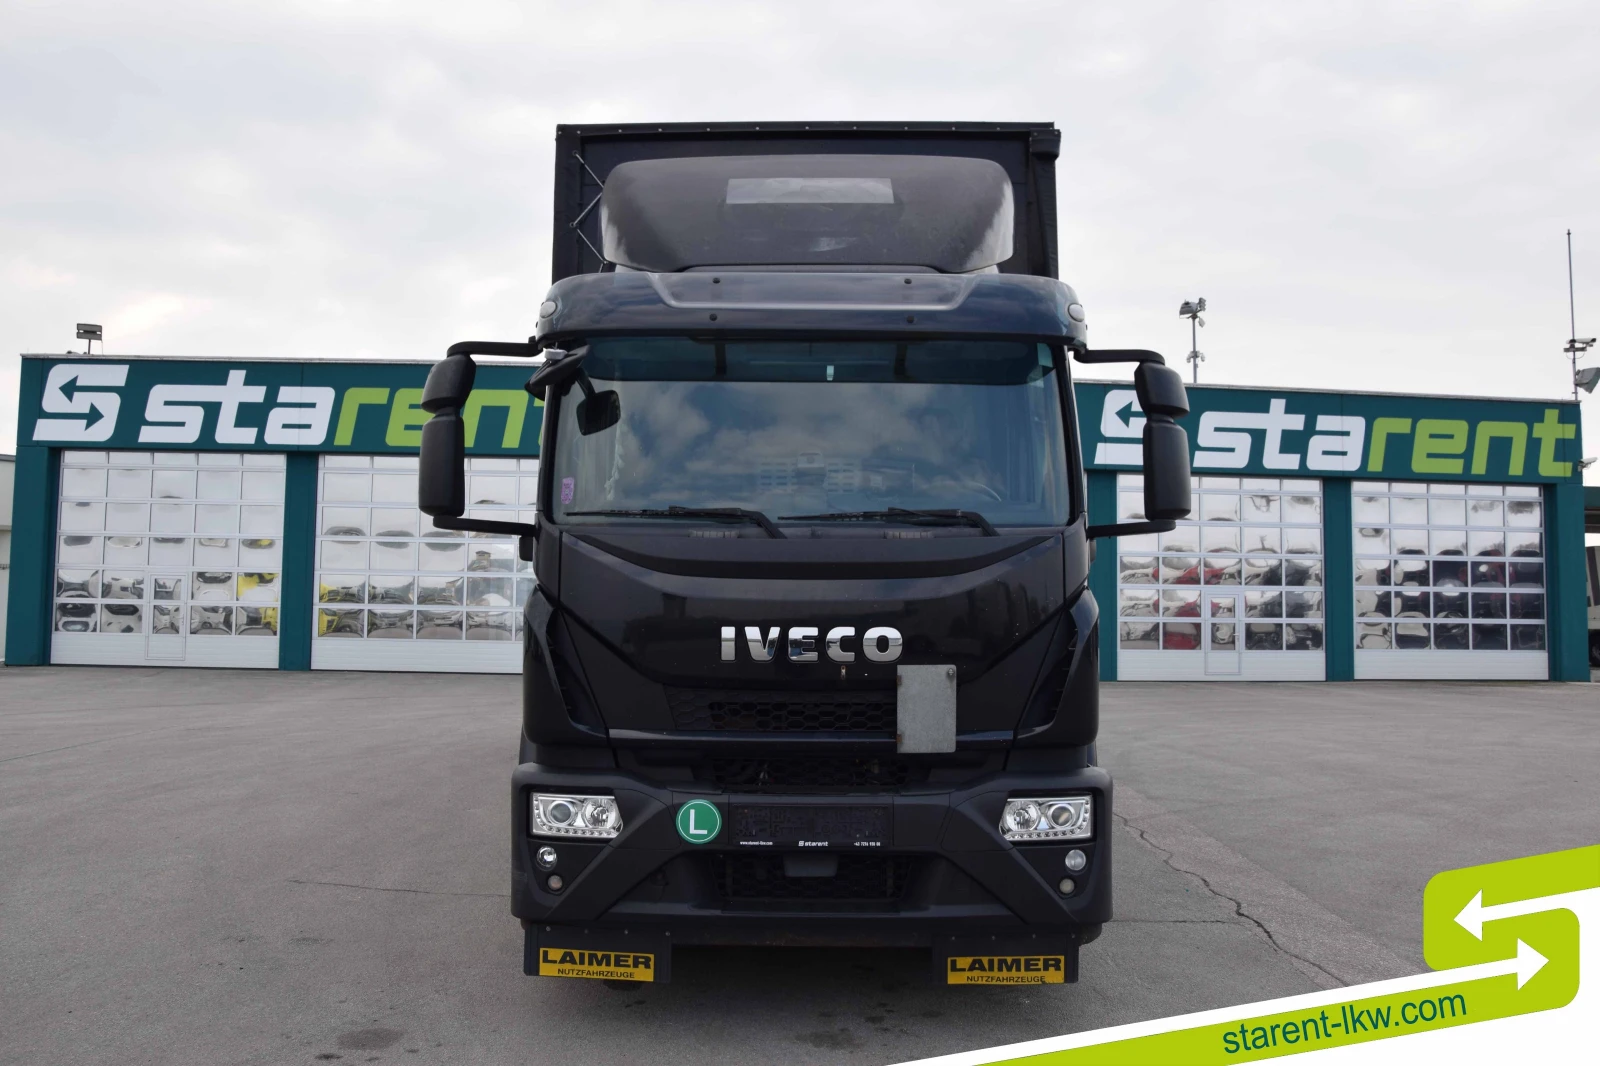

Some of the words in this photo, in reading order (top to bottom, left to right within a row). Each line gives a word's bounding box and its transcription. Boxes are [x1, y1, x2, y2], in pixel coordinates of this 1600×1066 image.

[138, 369, 545, 449] staren
[1193, 398, 1576, 477] starent
[721, 626, 903, 662] IVECO
[689, 808, 708, 835] L
[542, 949, 652, 969] LAIMER
[950, 958, 1062, 972] LAIMER
[557, 968, 635, 978] NUTZFAHRZEUGE
[966, 975, 1046, 983] NUTZFAHRZEUGE
